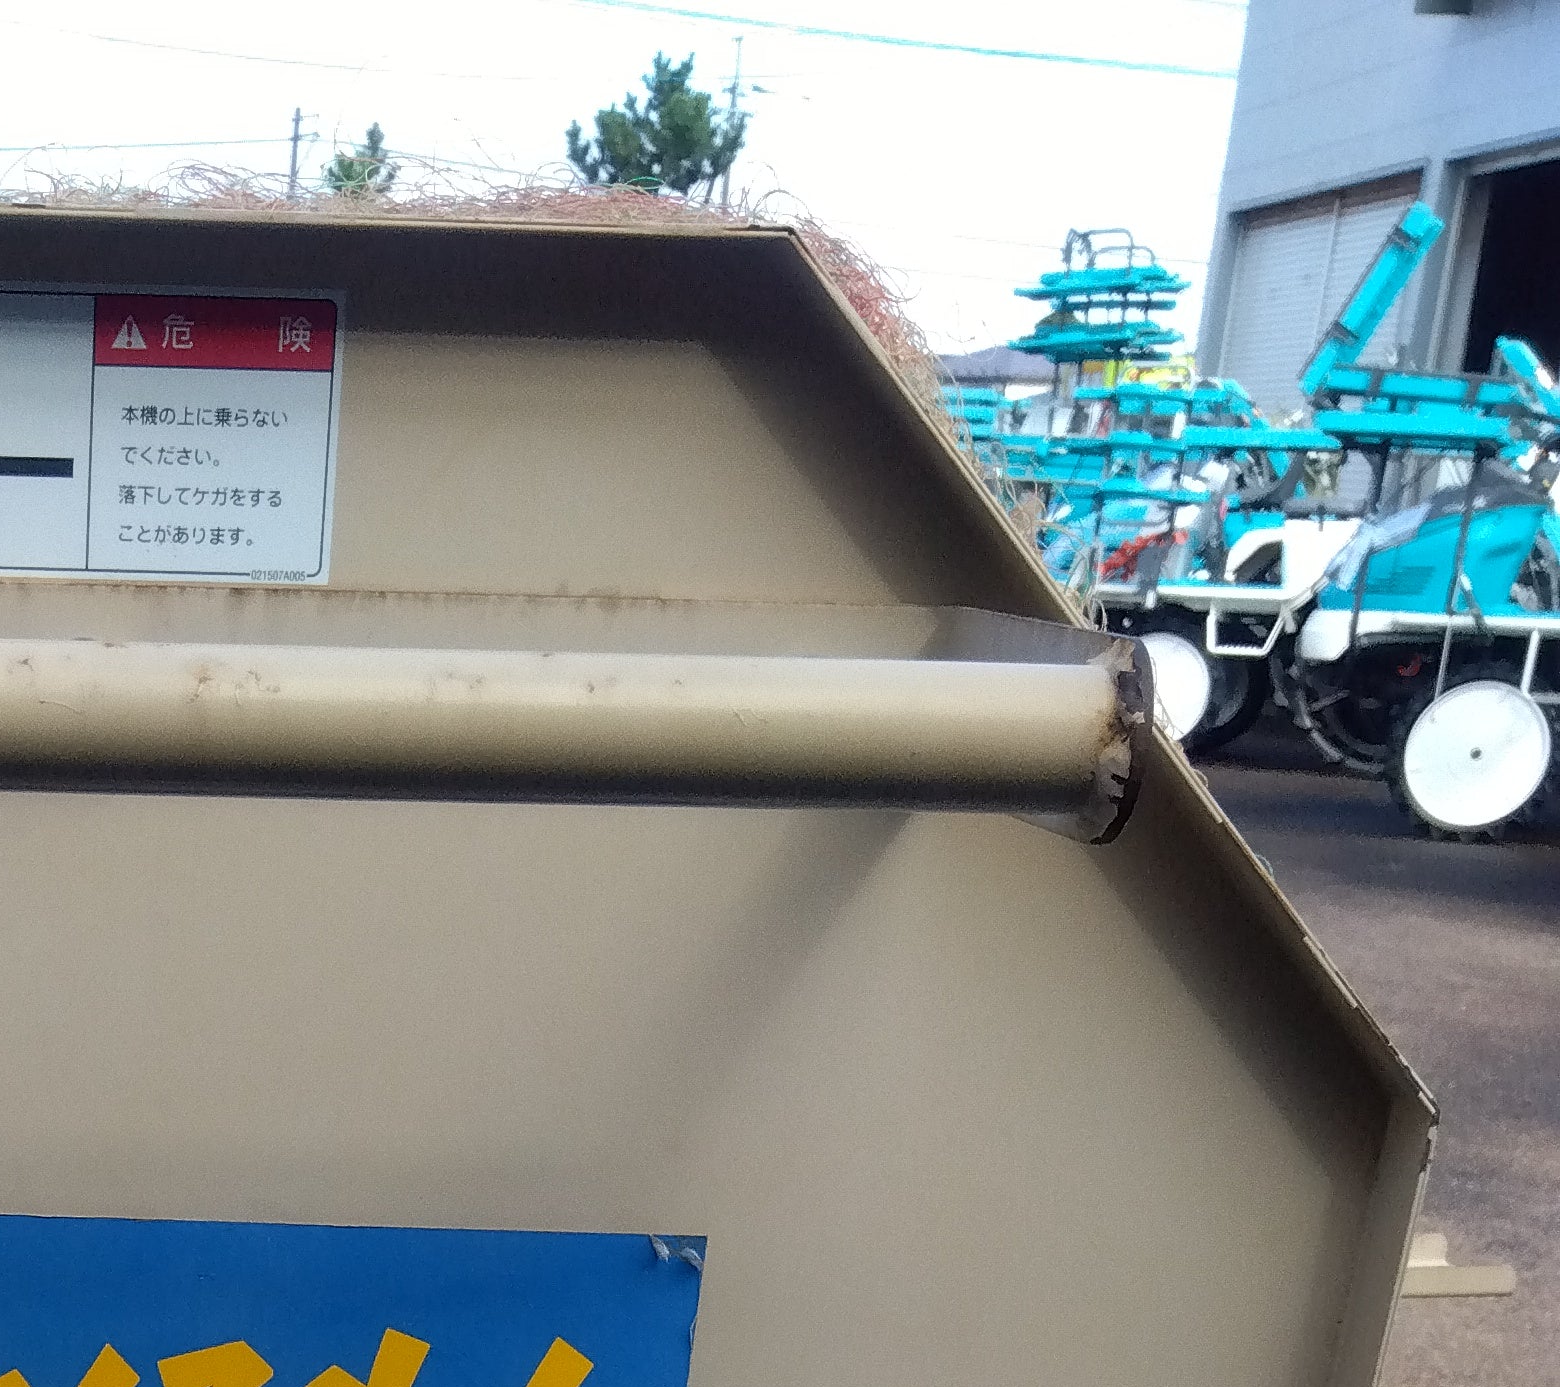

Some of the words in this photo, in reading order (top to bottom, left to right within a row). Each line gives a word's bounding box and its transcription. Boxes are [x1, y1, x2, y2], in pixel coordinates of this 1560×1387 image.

[162, 313, 312, 352] 危険
[121, 405, 288, 428] 本機の上に乗らない
[120, 446, 220, 467] でください。
[118, 485, 282, 508] 落下してケガをする
[118, 524, 254, 546] ことがあります。
